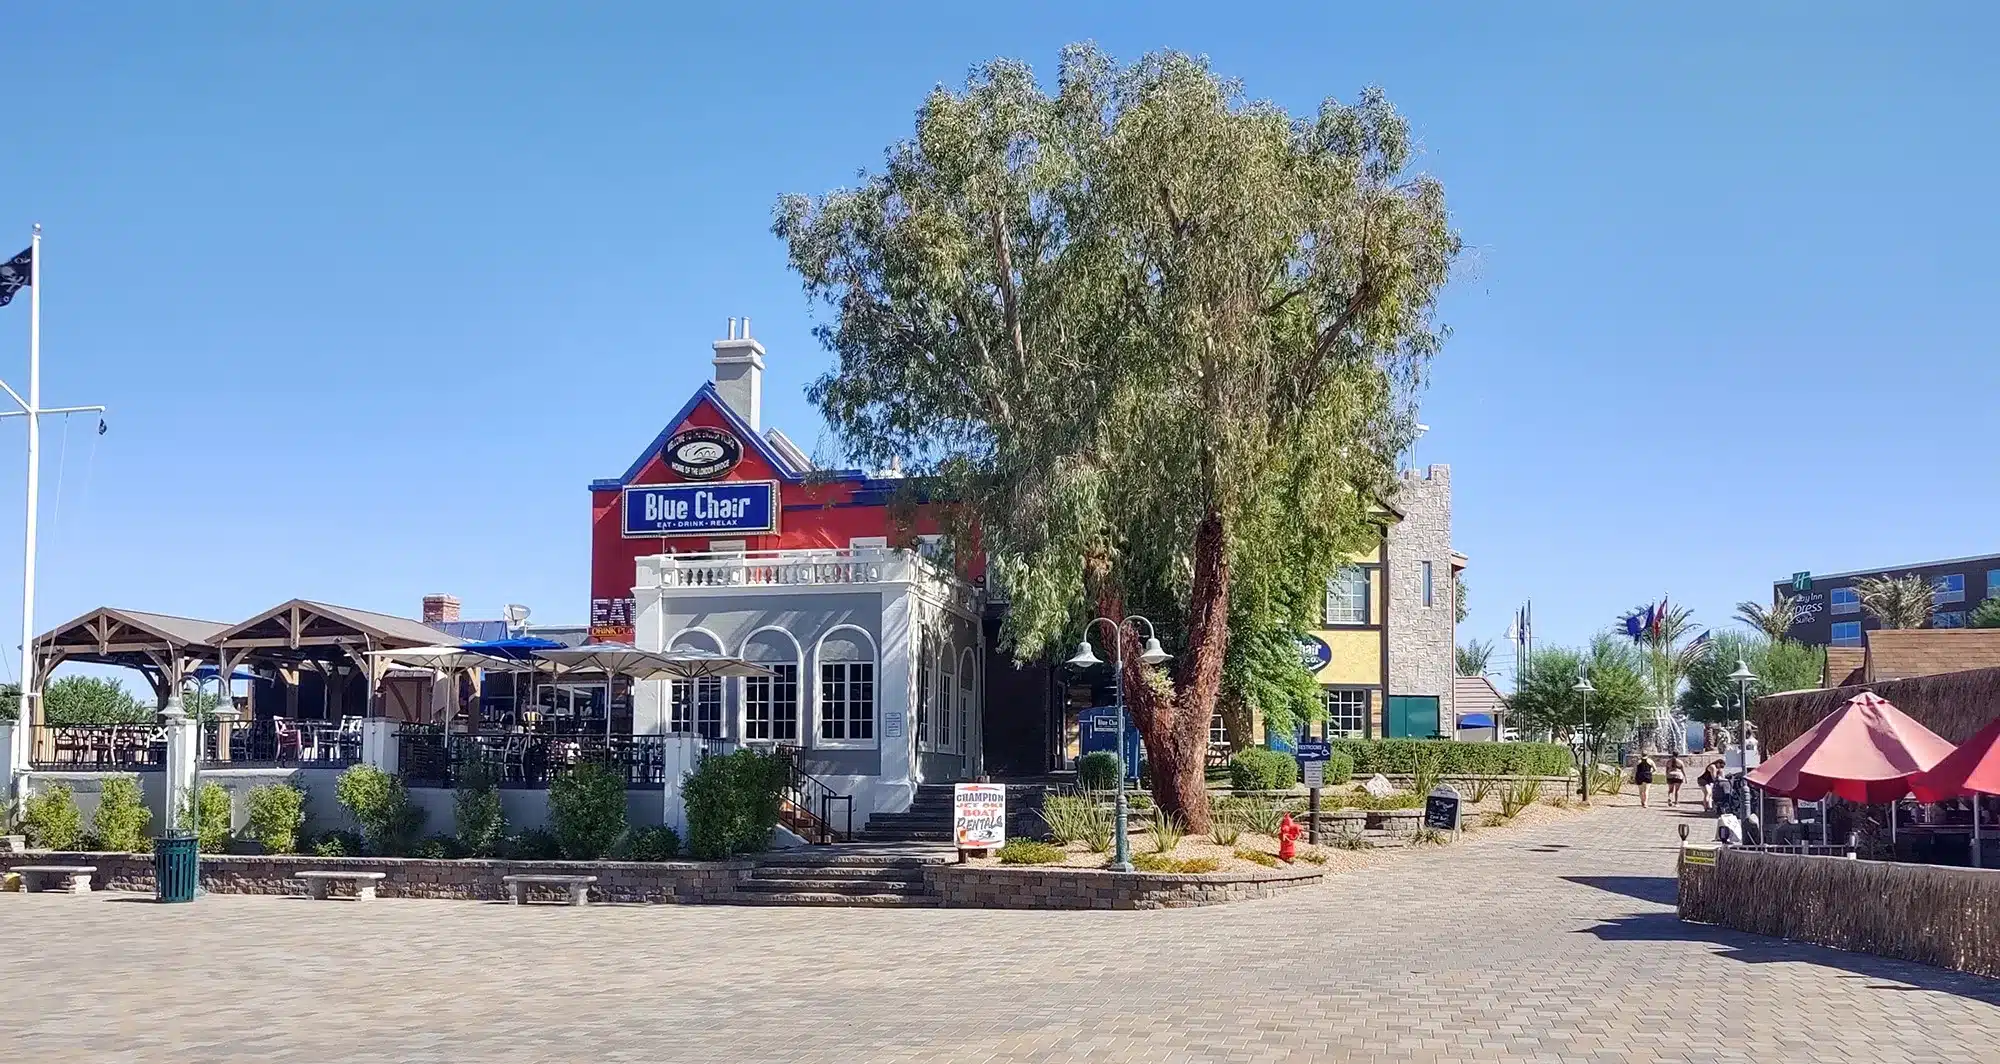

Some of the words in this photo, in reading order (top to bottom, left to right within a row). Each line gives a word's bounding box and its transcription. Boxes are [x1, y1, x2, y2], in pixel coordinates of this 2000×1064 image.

[672, 462, 685, 473] HOME
[685, 466, 691, 474] OF
[699, 466, 714, 475] LONDON
[714, 459, 730, 473] BRIDGE
[645, 493, 688, 521] Blue
[695, 491, 751, 519] Chair
[678, 520, 704, 528] DRINK
[591, 627, 617, 636] DRINK
[956, 793, 1004, 802] CHAMPION
[956, 815, 1003, 831] RENTALS
